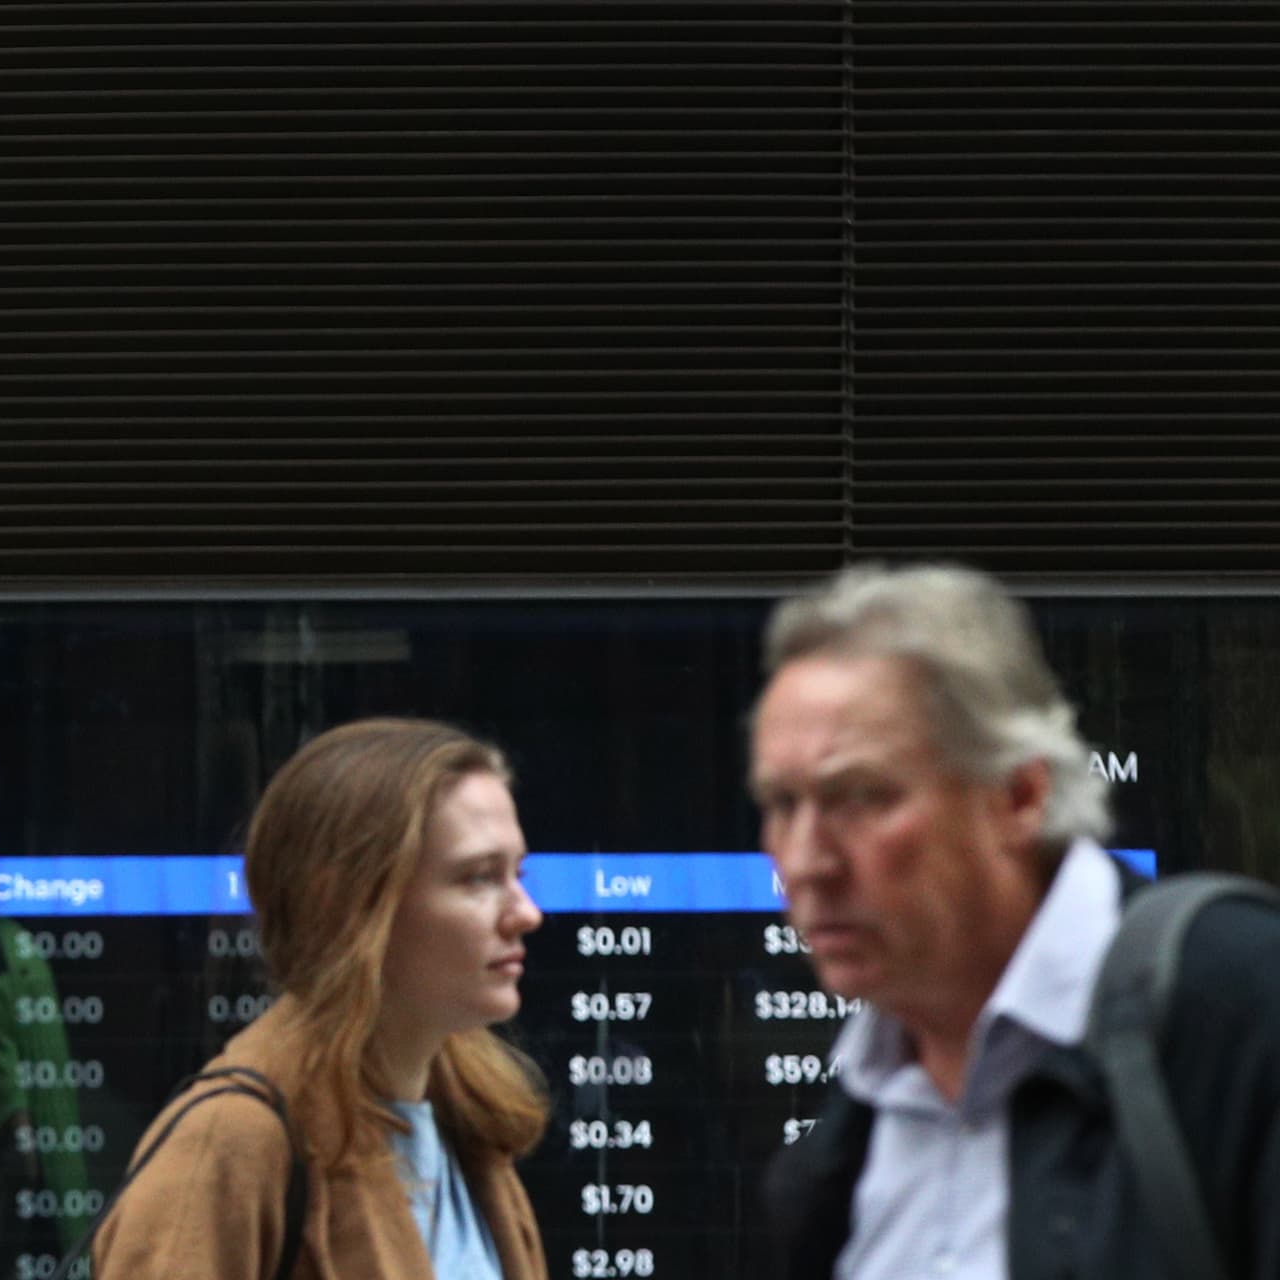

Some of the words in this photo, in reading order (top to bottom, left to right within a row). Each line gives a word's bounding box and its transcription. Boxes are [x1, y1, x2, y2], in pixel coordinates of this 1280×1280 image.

[1089, 751, 1138, 783] AM
[595, 872, 651, 897] Low
[15, 930, 104, 959] $0.00
[576, 927, 652, 957] $0.01
[16, 997, 104, 1024] $0.00
[572, 992, 652, 1021] $0.57
[16, 1060, 104, 1088] $0.00
[569, 1056, 652, 1086] $0.08
[15, 1126, 105, 1153] $0.00
[570, 1120, 652, 1150] $0.34
[16, 1190, 104, 1218] $0.00
[582, 1185, 654, 1215] $1.70
[573, 1249, 654, 1279] $2.98
